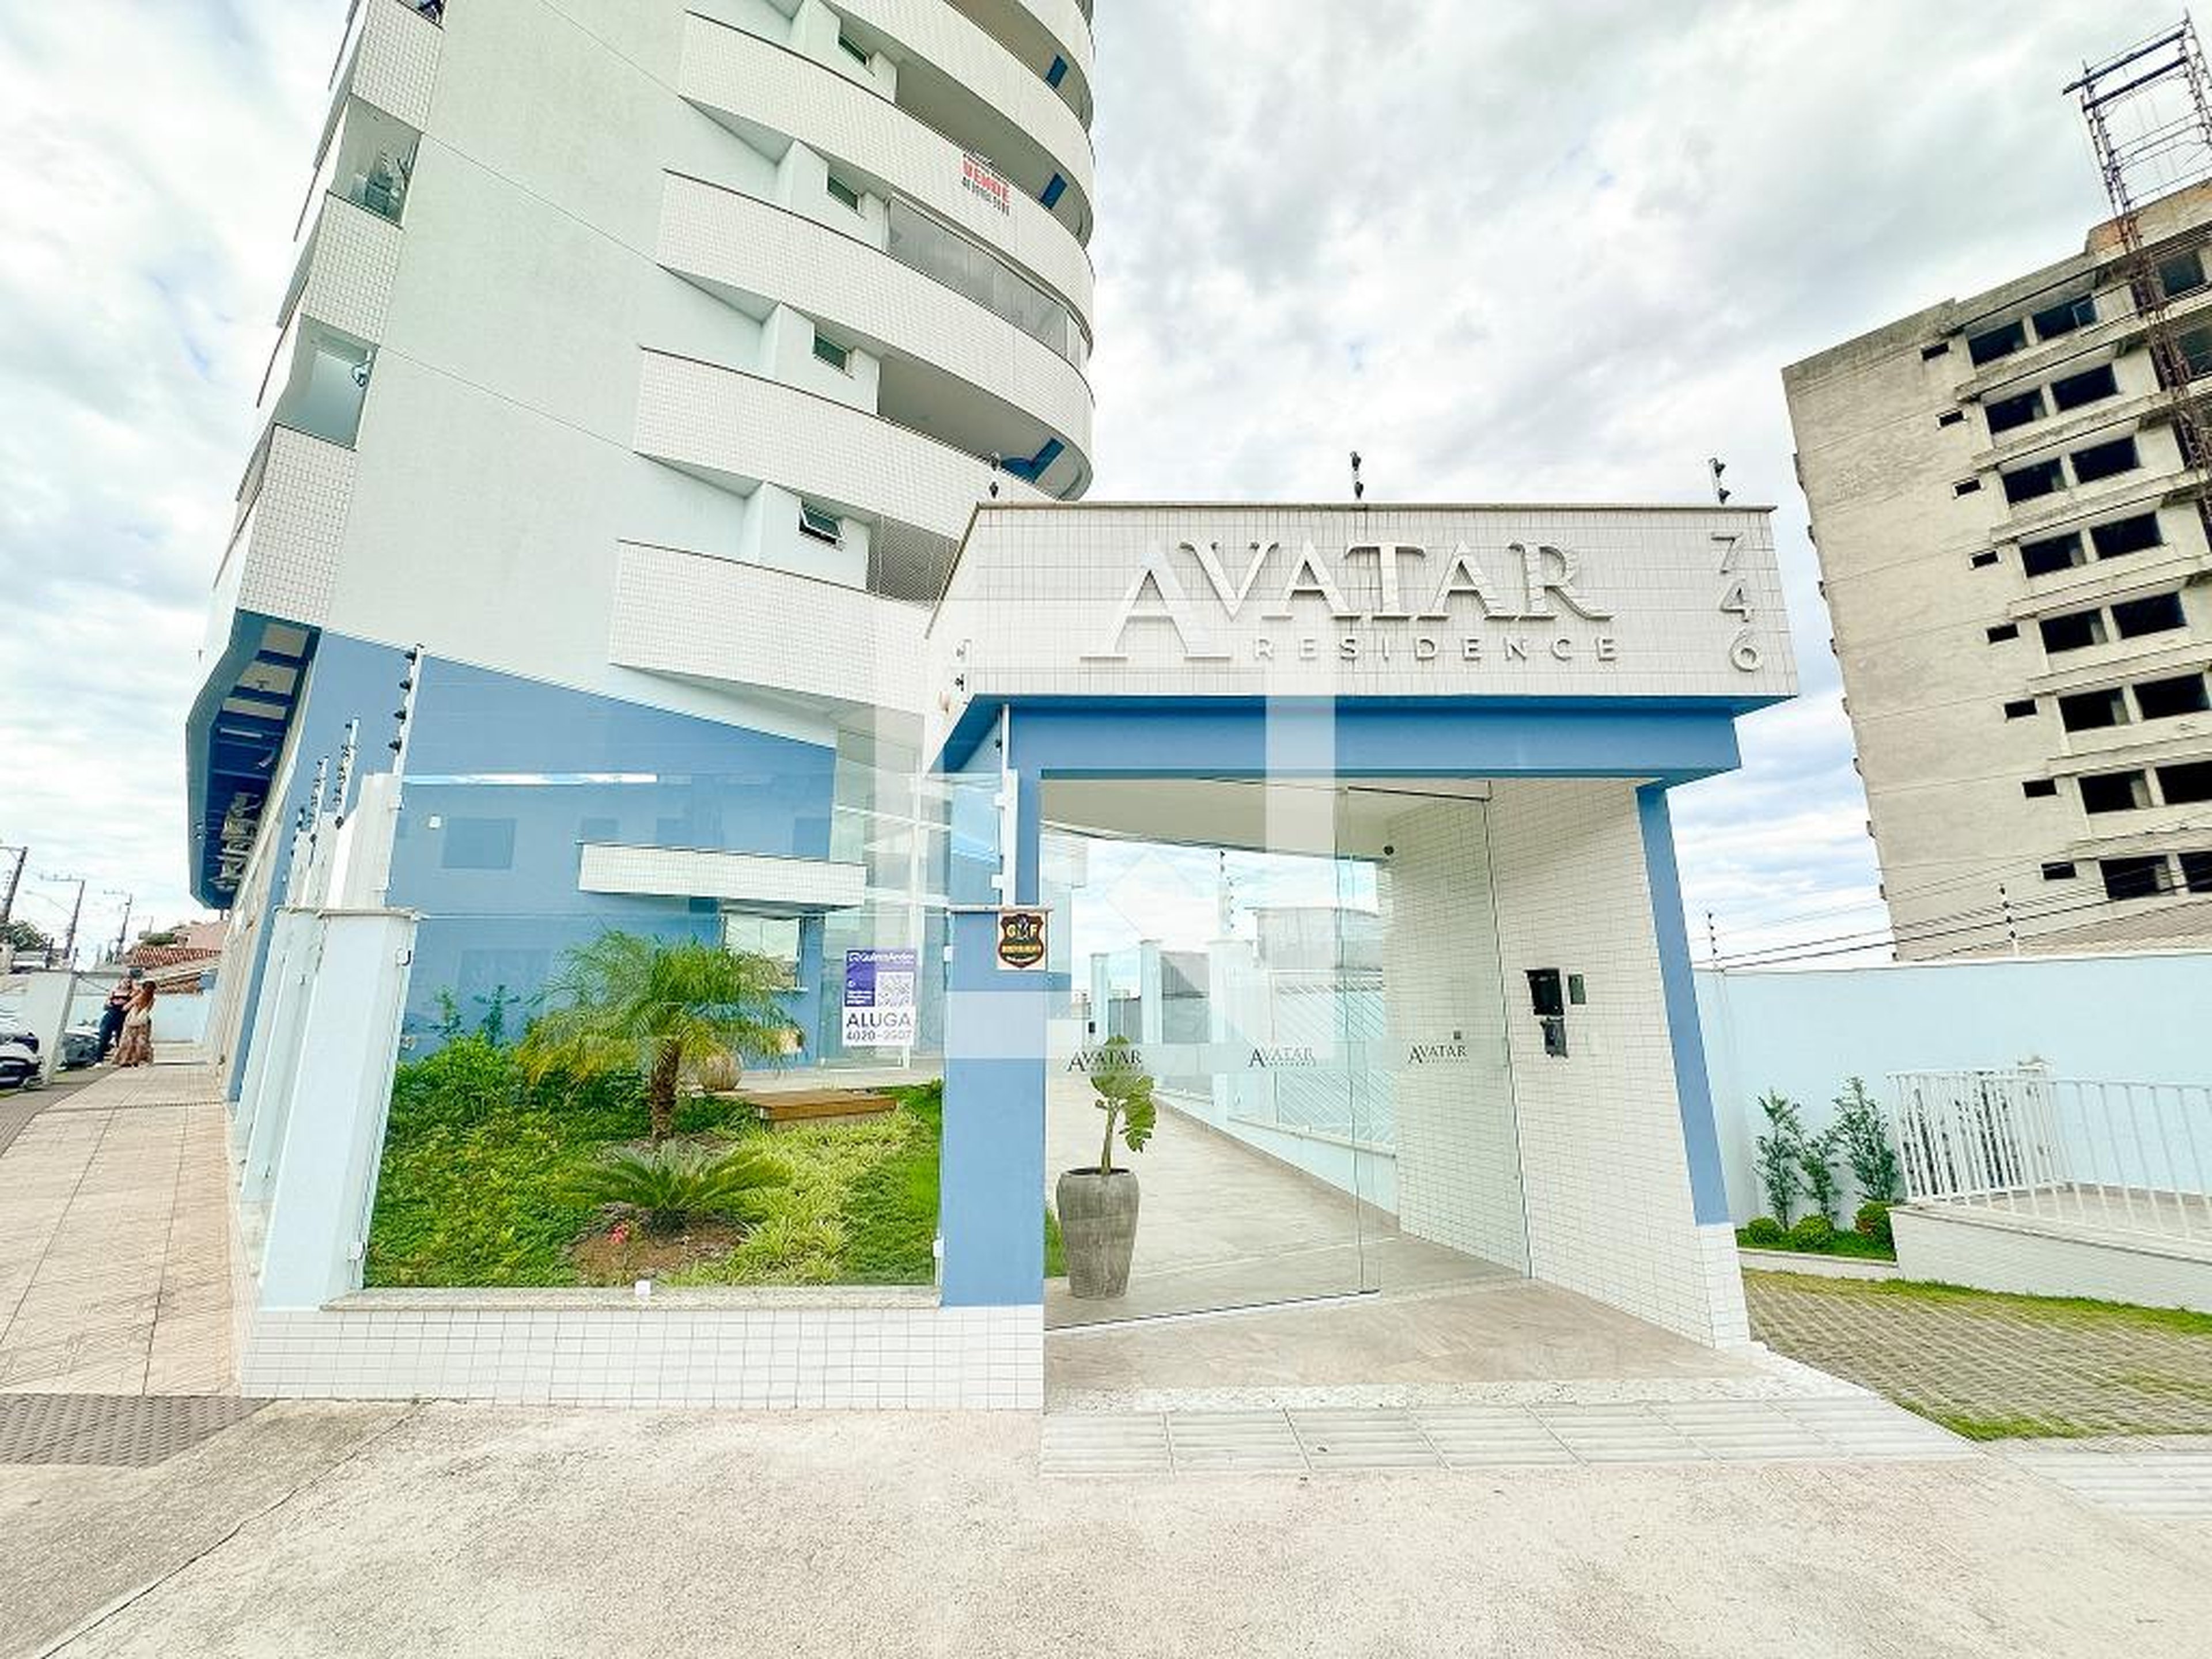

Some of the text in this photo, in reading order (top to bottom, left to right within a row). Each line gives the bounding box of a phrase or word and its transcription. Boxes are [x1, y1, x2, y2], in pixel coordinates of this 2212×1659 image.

[1080, 540, 1615, 661] AVATAR
[1254, 638, 1619, 661] RESIDENCE
[846, 1012, 911, 1028] ALUGA
[1066, 1050, 1142, 1072] AVATAR
[1247, 1047, 1316, 1067] AVATAR
[1408, 1044, 1468, 1064] AVATAR
